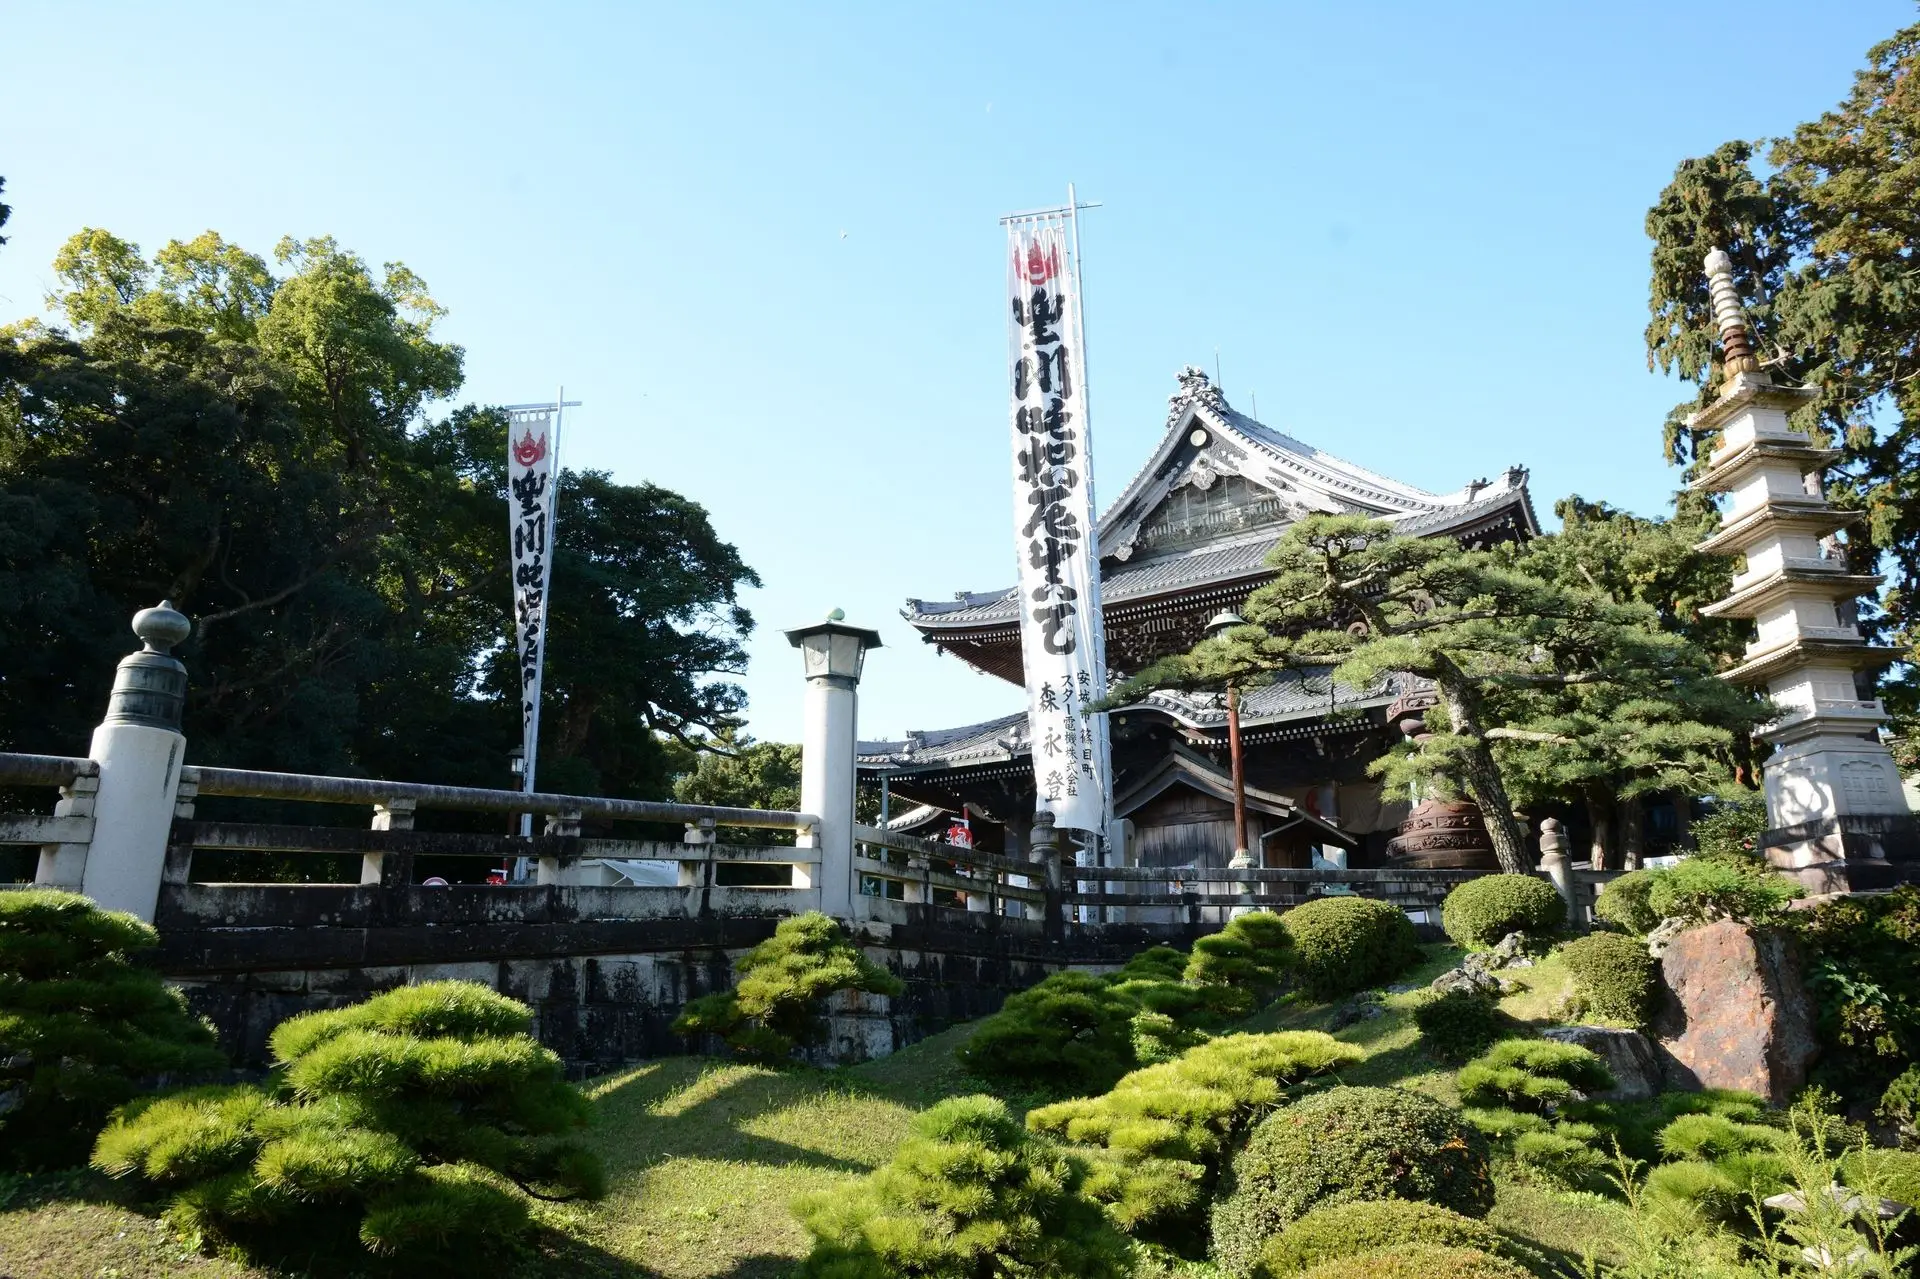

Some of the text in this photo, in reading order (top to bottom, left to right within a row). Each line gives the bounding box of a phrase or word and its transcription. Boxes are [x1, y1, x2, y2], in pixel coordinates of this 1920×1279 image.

[1039, 682, 1065, 803] 森永登
[1061, 675, 1078, 797] スター電機株式会社
